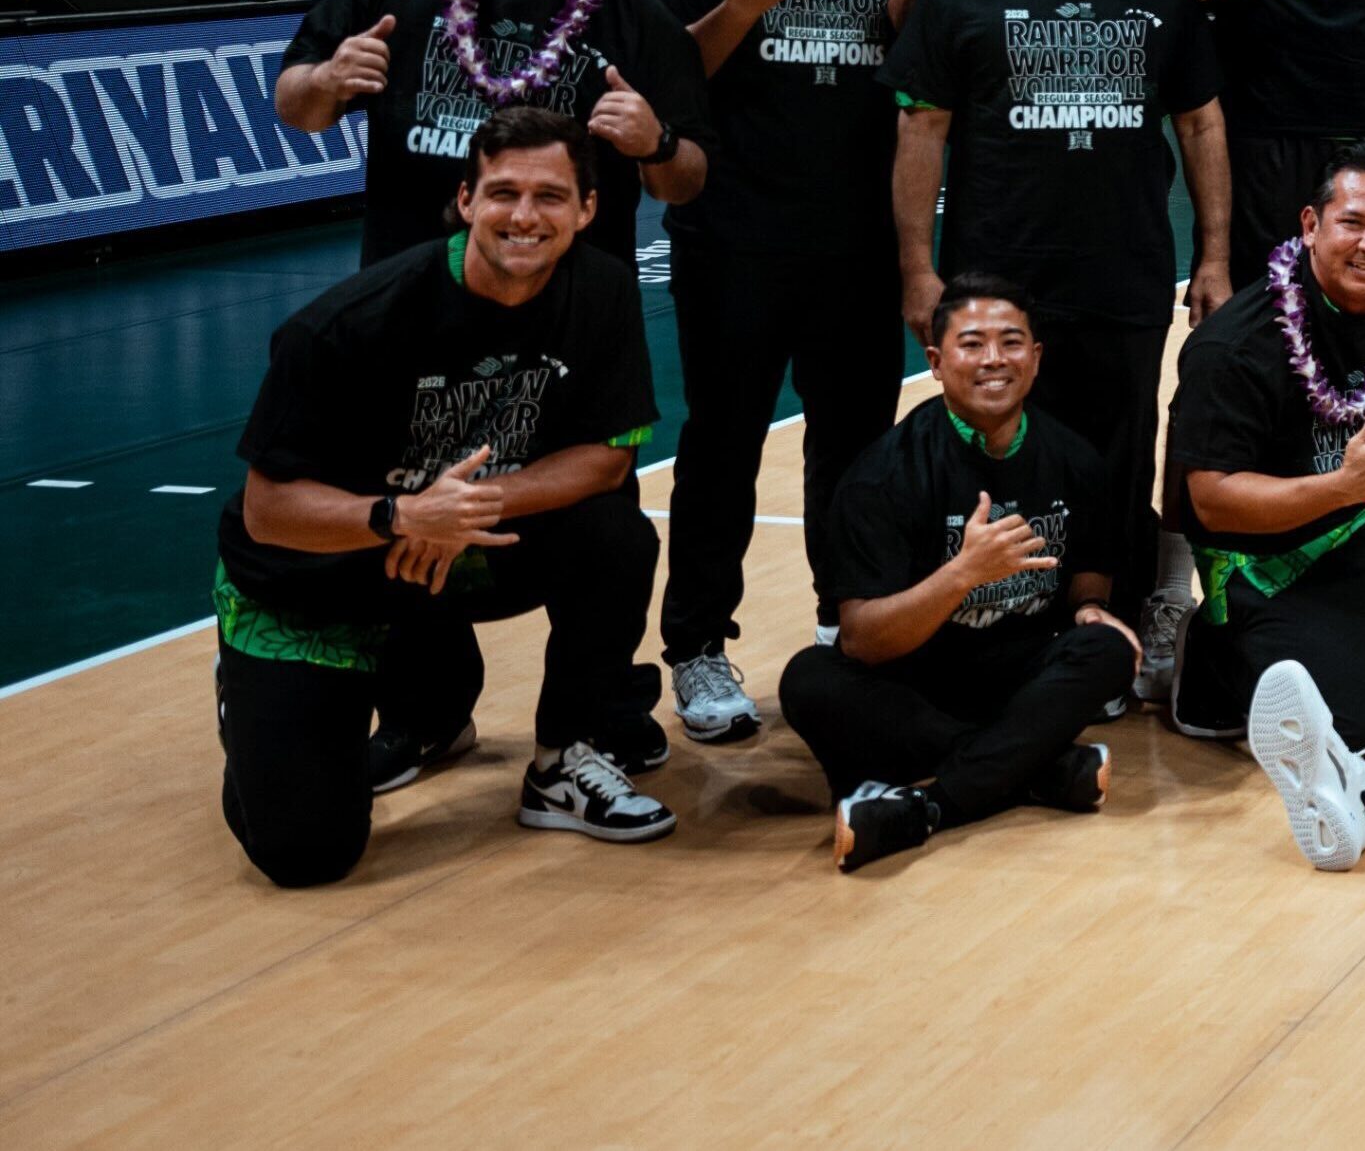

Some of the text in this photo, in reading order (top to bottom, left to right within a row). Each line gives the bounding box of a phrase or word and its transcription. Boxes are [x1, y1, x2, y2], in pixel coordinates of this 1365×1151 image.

[789, 29, 862, 40] REGULAR SEASON
[1004, 20, 1146, 48] RAINBOW
[760, 38, 884, 66] CHAMPIONS
[1008, 47, 1146, 75] WARRIOR
[1037, 94, 1119, 104] REGULAR SEASON
[1009, 105, 1144, 130] CHAMPIONS
[417, 376, 446, 388] 2026
